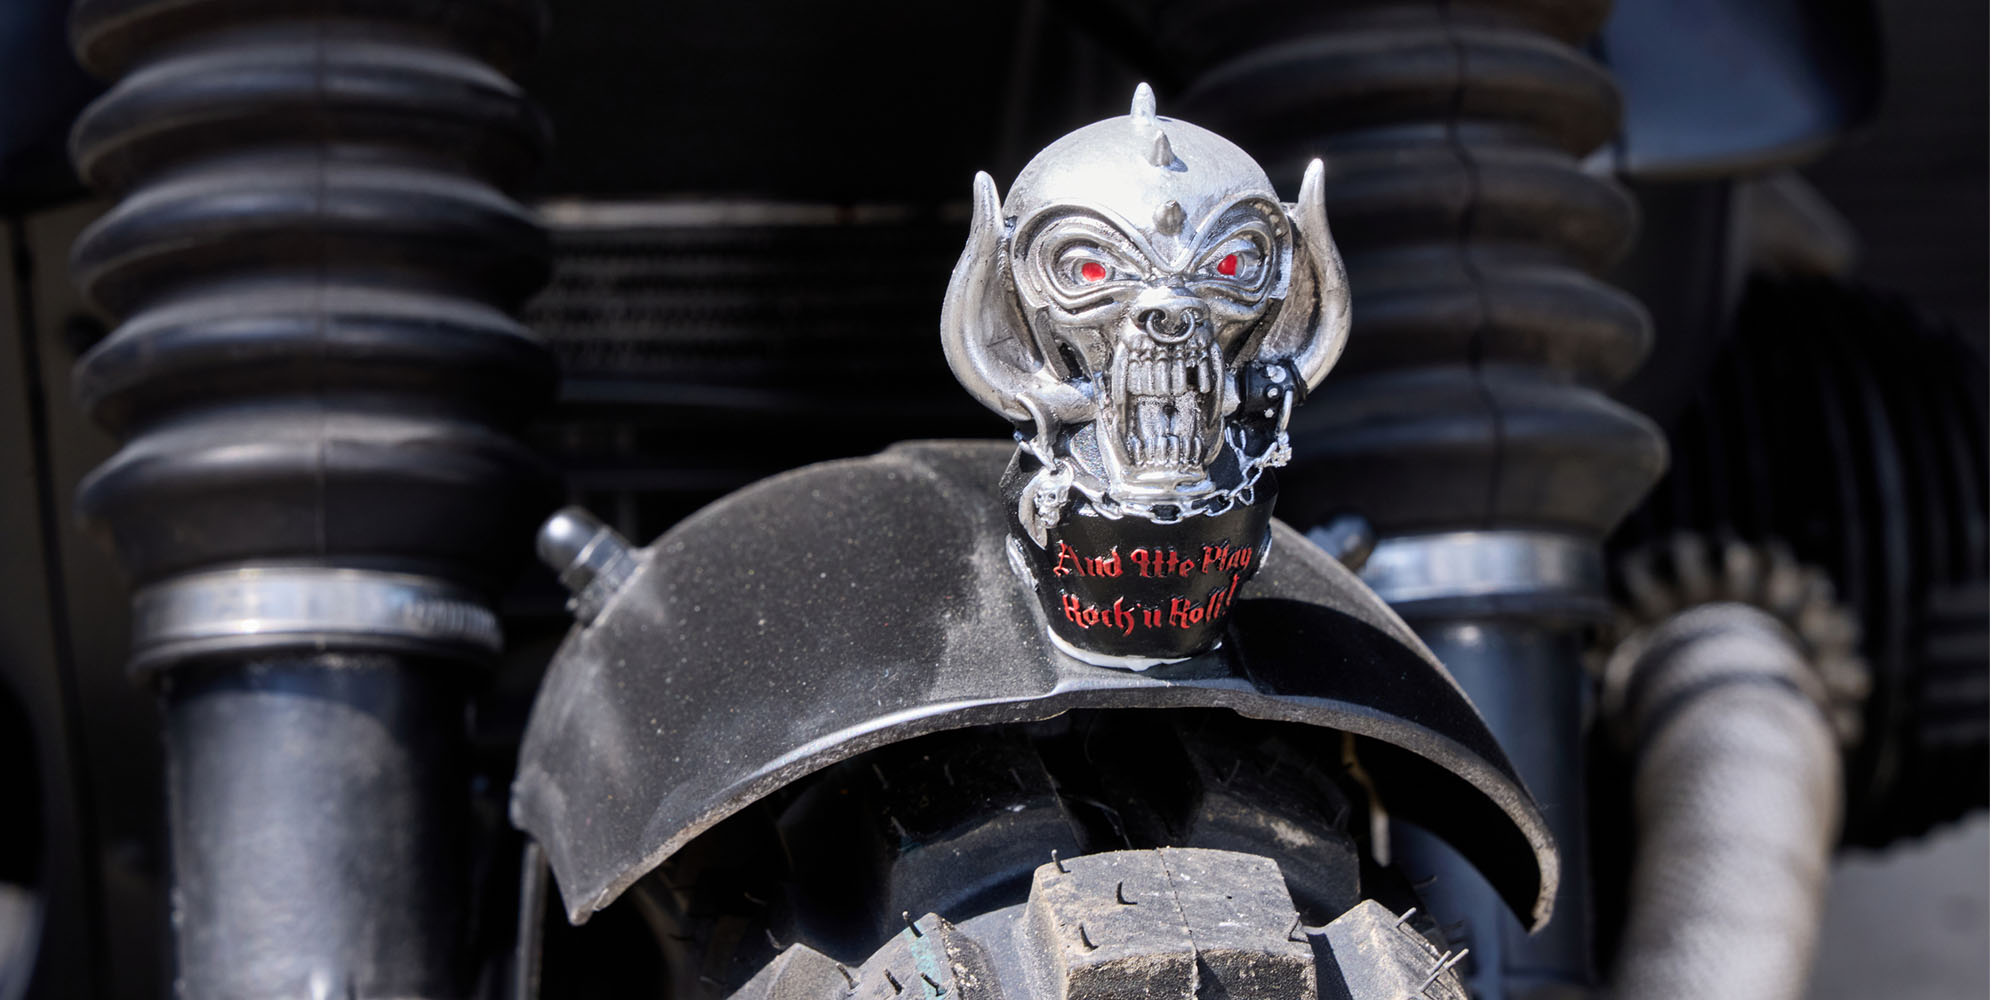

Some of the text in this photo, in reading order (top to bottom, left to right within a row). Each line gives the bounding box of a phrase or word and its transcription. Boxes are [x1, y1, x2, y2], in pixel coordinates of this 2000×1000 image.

[1053, 540, 1253, 578] And We Play
[1168, 575, 1240, 629] Roll!
